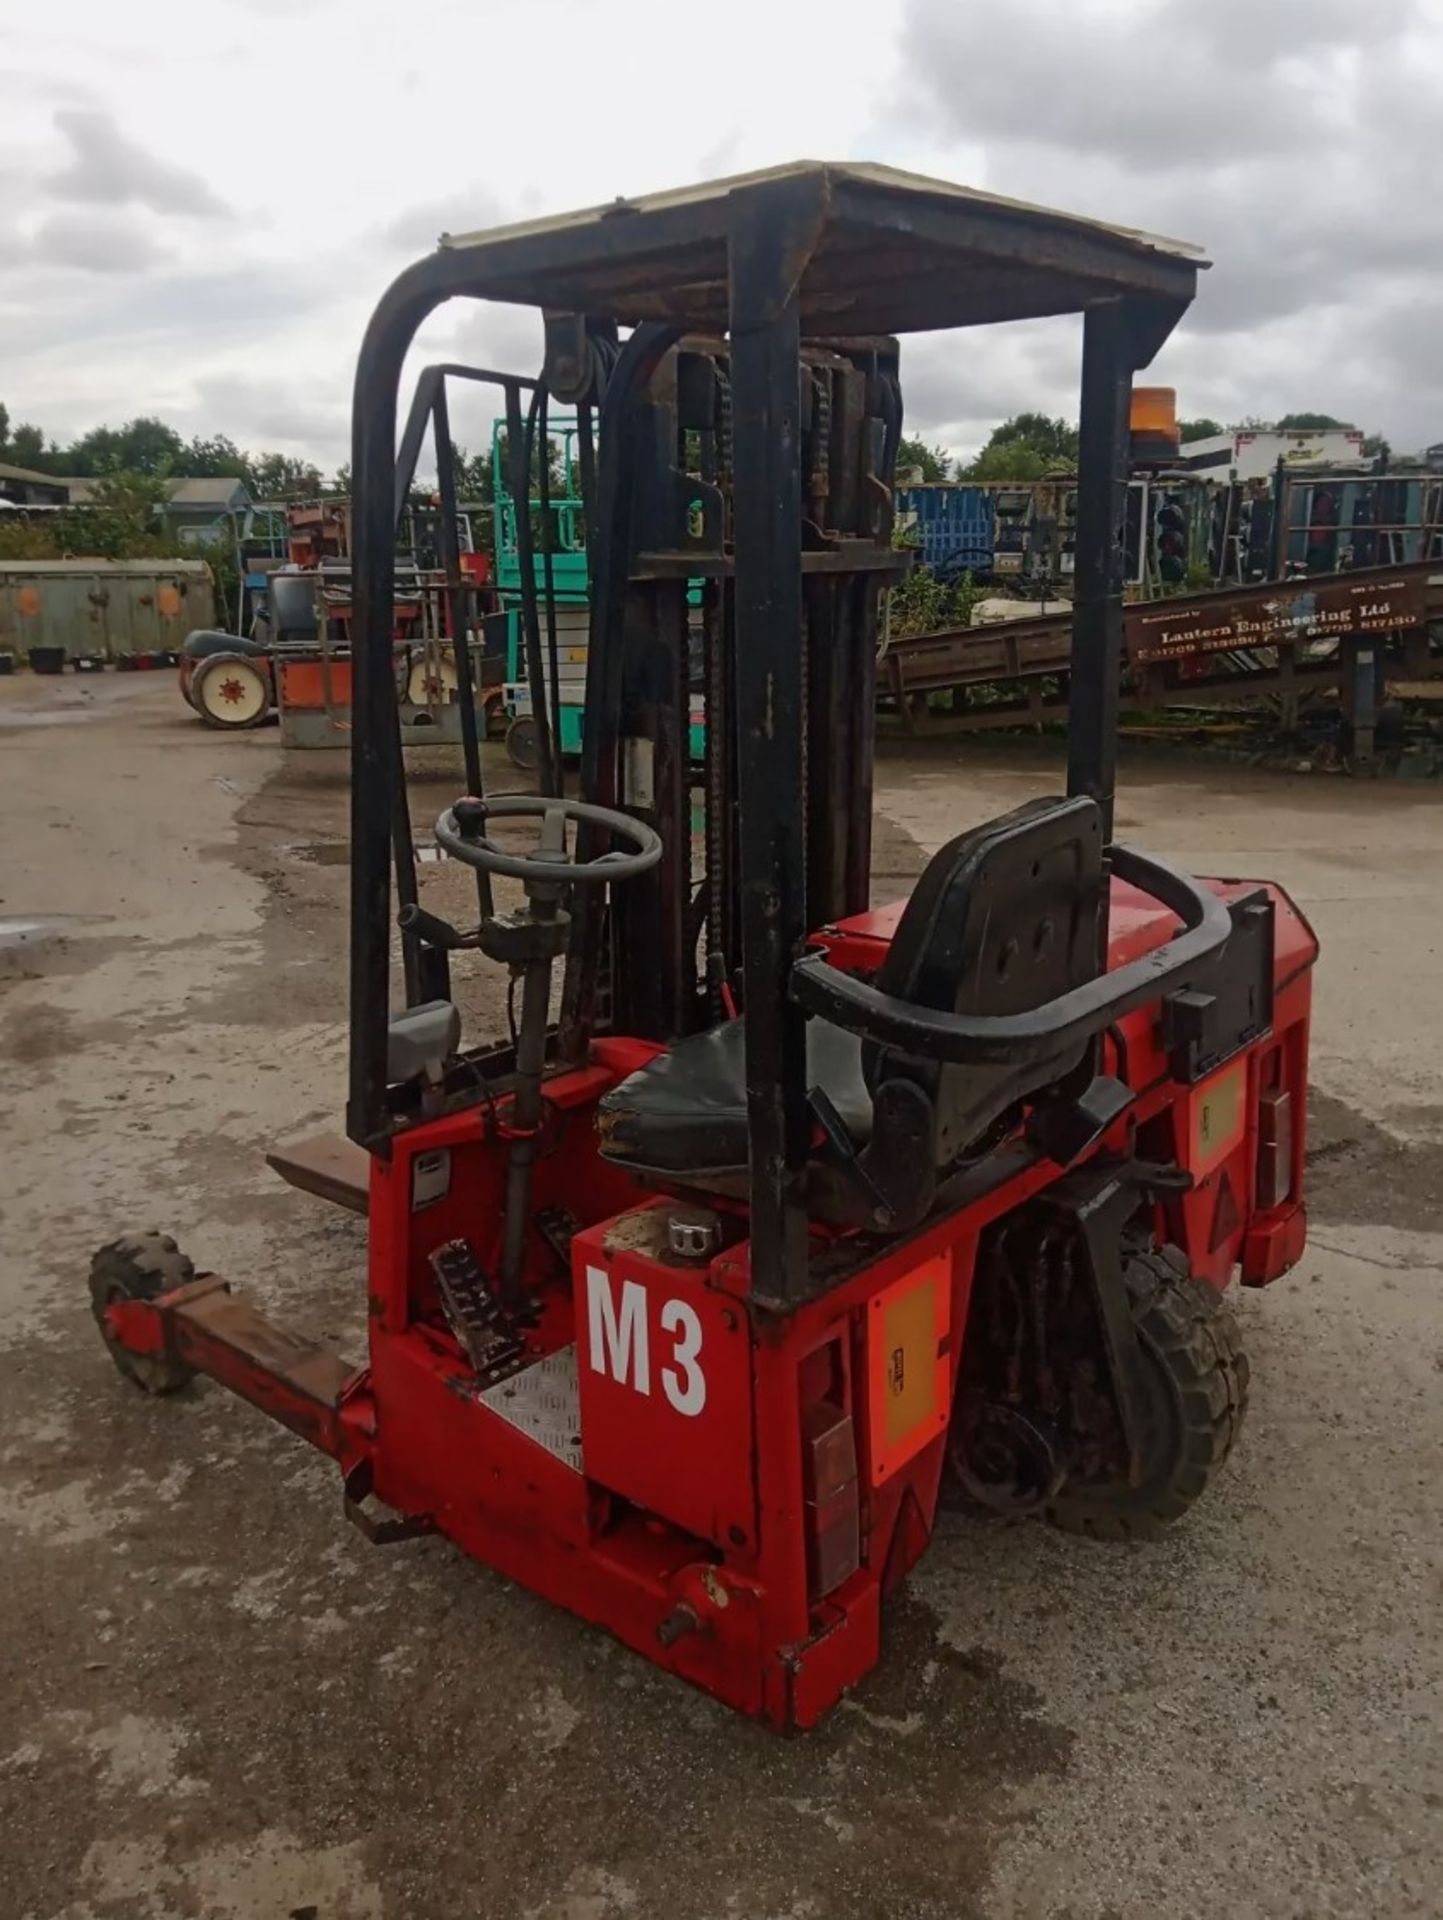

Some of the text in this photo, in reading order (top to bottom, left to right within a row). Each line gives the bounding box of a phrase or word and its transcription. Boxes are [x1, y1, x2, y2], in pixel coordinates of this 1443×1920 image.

[1161, 602, 1391, 644] Lantern Engineering Ltd
[586, 1265, 707, 1417] M3
